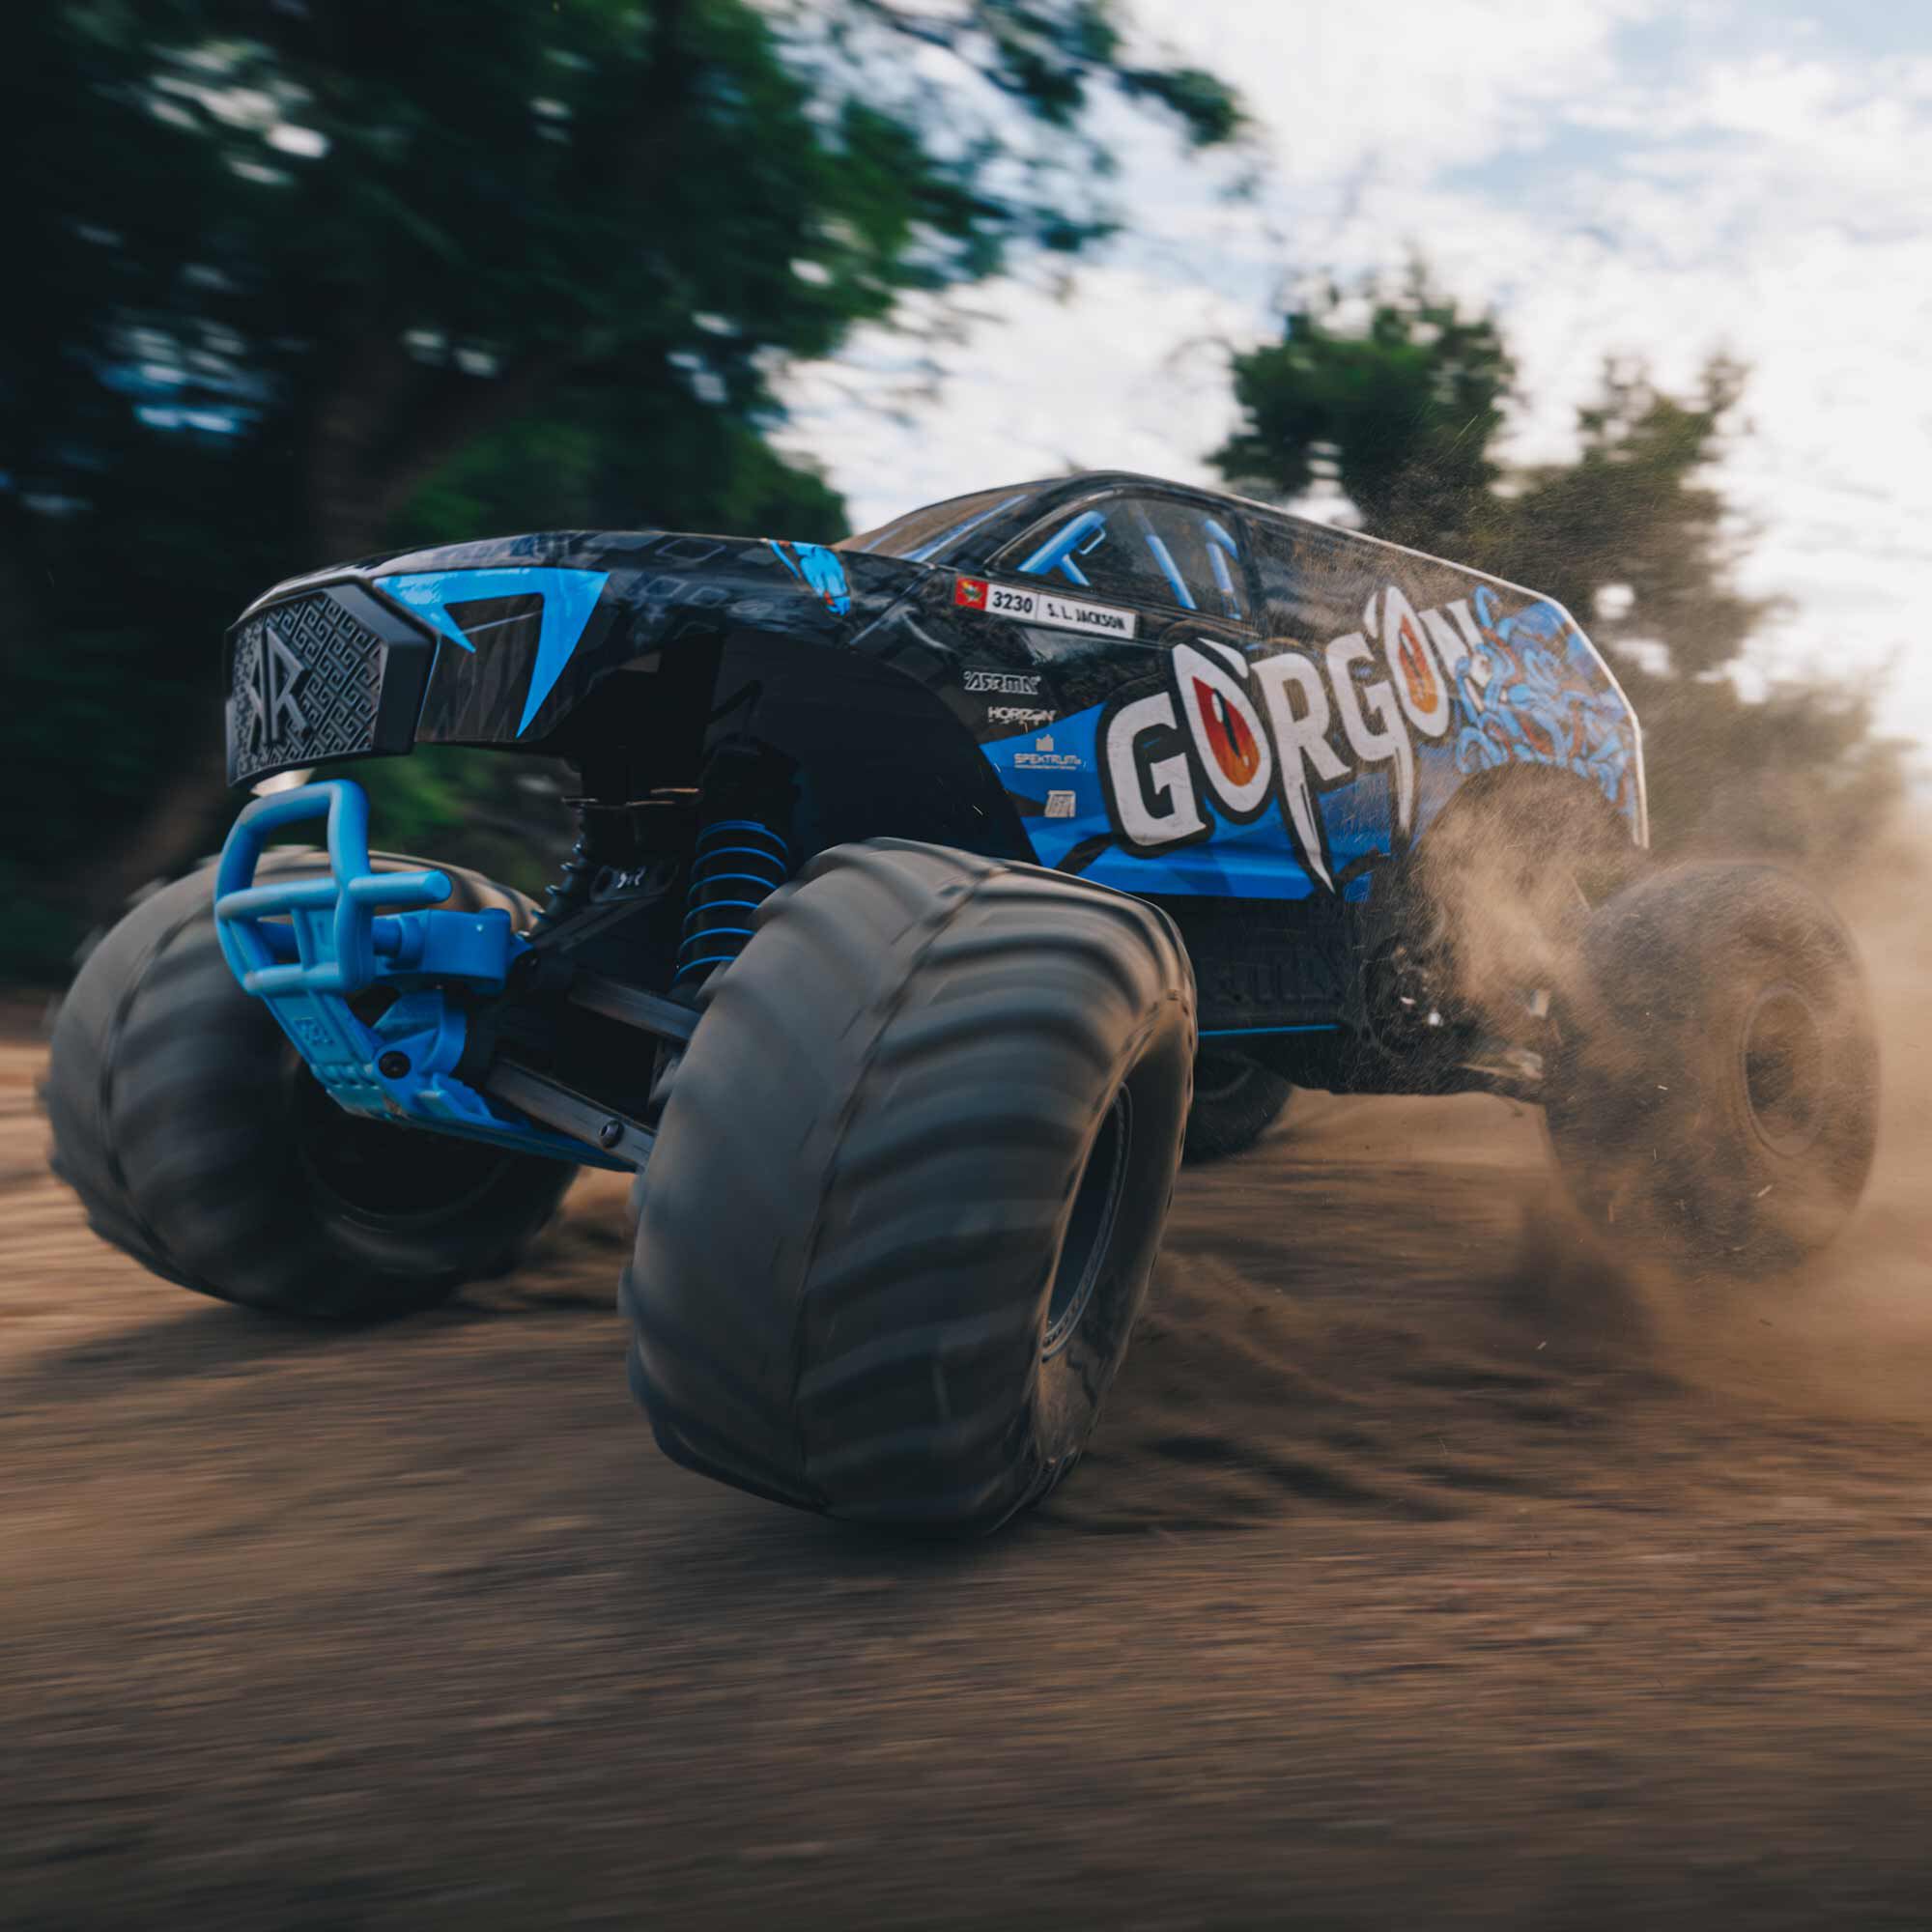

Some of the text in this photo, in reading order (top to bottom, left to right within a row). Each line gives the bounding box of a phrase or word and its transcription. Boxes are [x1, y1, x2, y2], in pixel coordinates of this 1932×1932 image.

[992, 590, 1034, 613] 3230
[1075, 608, 1126, 631] JACKSON
[1107, 585, 1493, 894] GORGON
